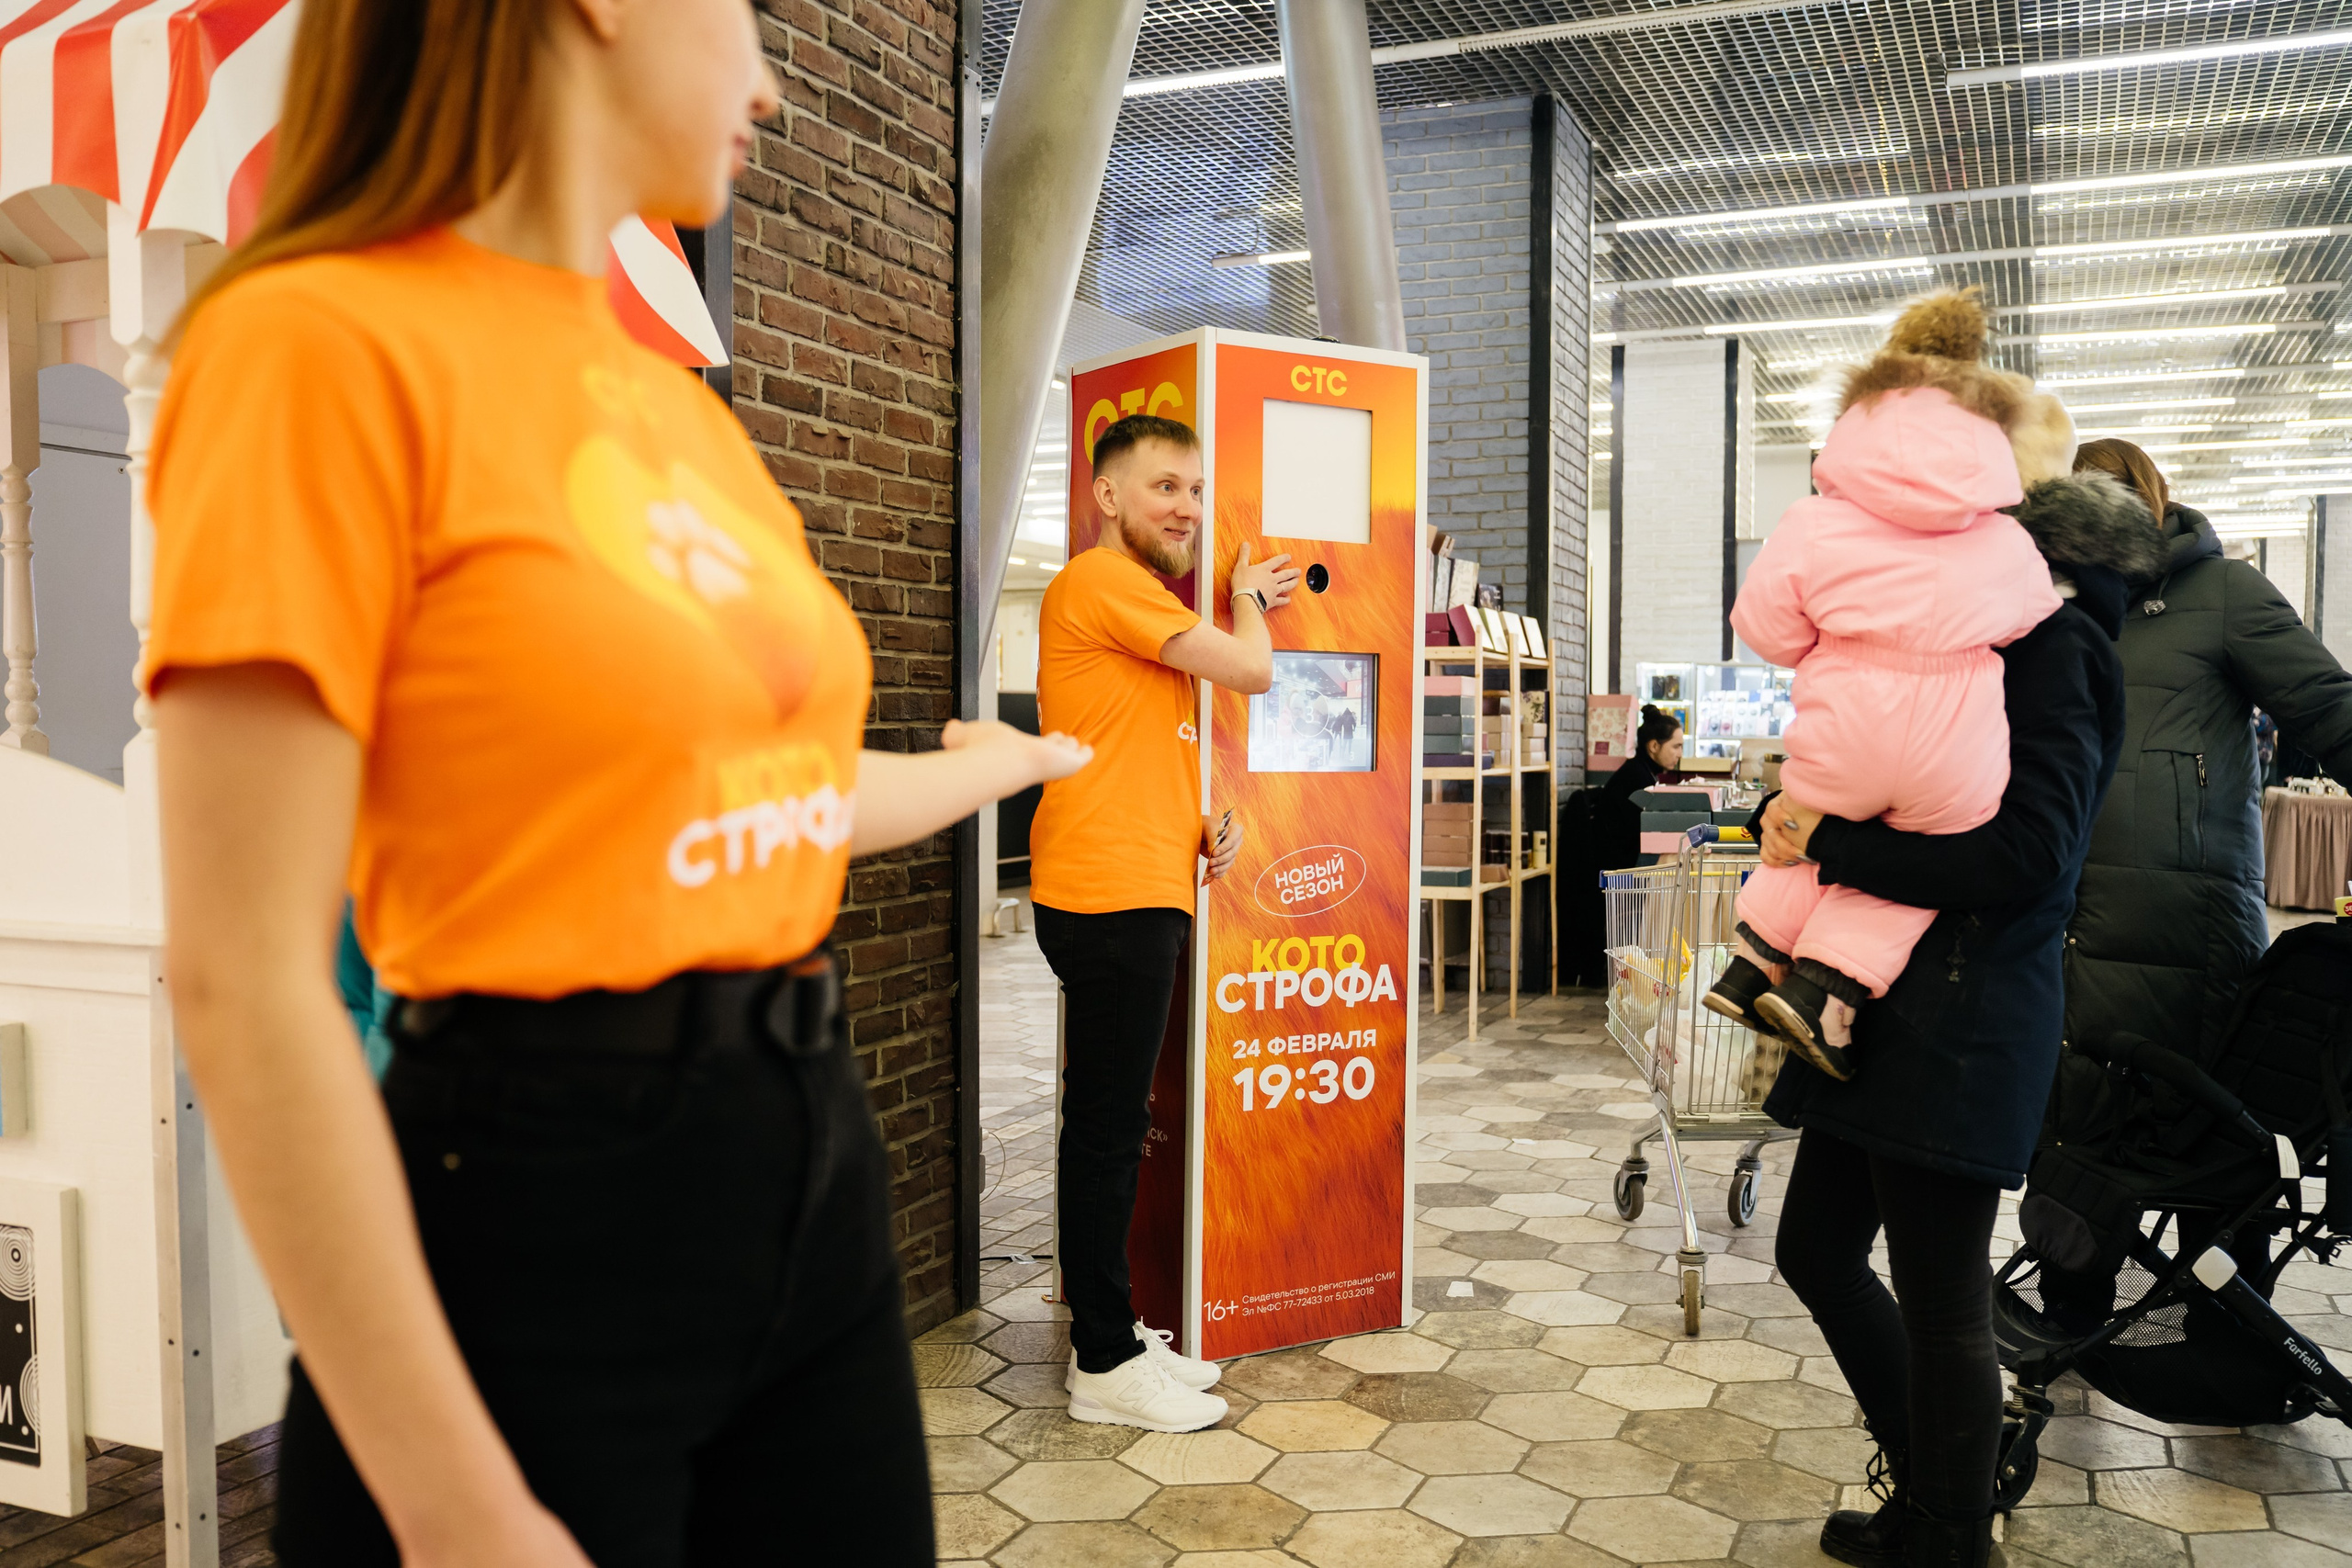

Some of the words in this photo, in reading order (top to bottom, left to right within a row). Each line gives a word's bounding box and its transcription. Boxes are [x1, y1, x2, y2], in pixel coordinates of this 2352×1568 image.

[1290, 365, 1348, 397] СТС
[1274, 852, 1344, 888] НОВЫЙ
[1280, 874, 1344, 905] СЕЗОН
[1252, 933, 1365, 976] КОТО
[1216, 962, 1397, 1013] СТРОФА
[1233, 1039, 1261, 1059] 24
[1267, 1029, 1376, 1055] ФЕВРАЛЯ
[1233, 1056, 1375, 1111] 19:30
[1242, 1287, 1309, 1304] Свидетельство
[1317, 1276, 1374, 1294] регистрации
[1374, 1270, 1396, 1282] СМИ
[1242, 1306, 1254, 1316] Эл
[1256, 1302, 1282, 1314] №ФС
[1283, 1296, 1323, 1309] 77-72433
[1324, 1294, 1334, 1303] от
[1335, 1286, 1375, 1301] 5.03.2018
[1204, 1299, 1239, 1322] 16+
[2283, 1337, 2323, 1375] Farfello
